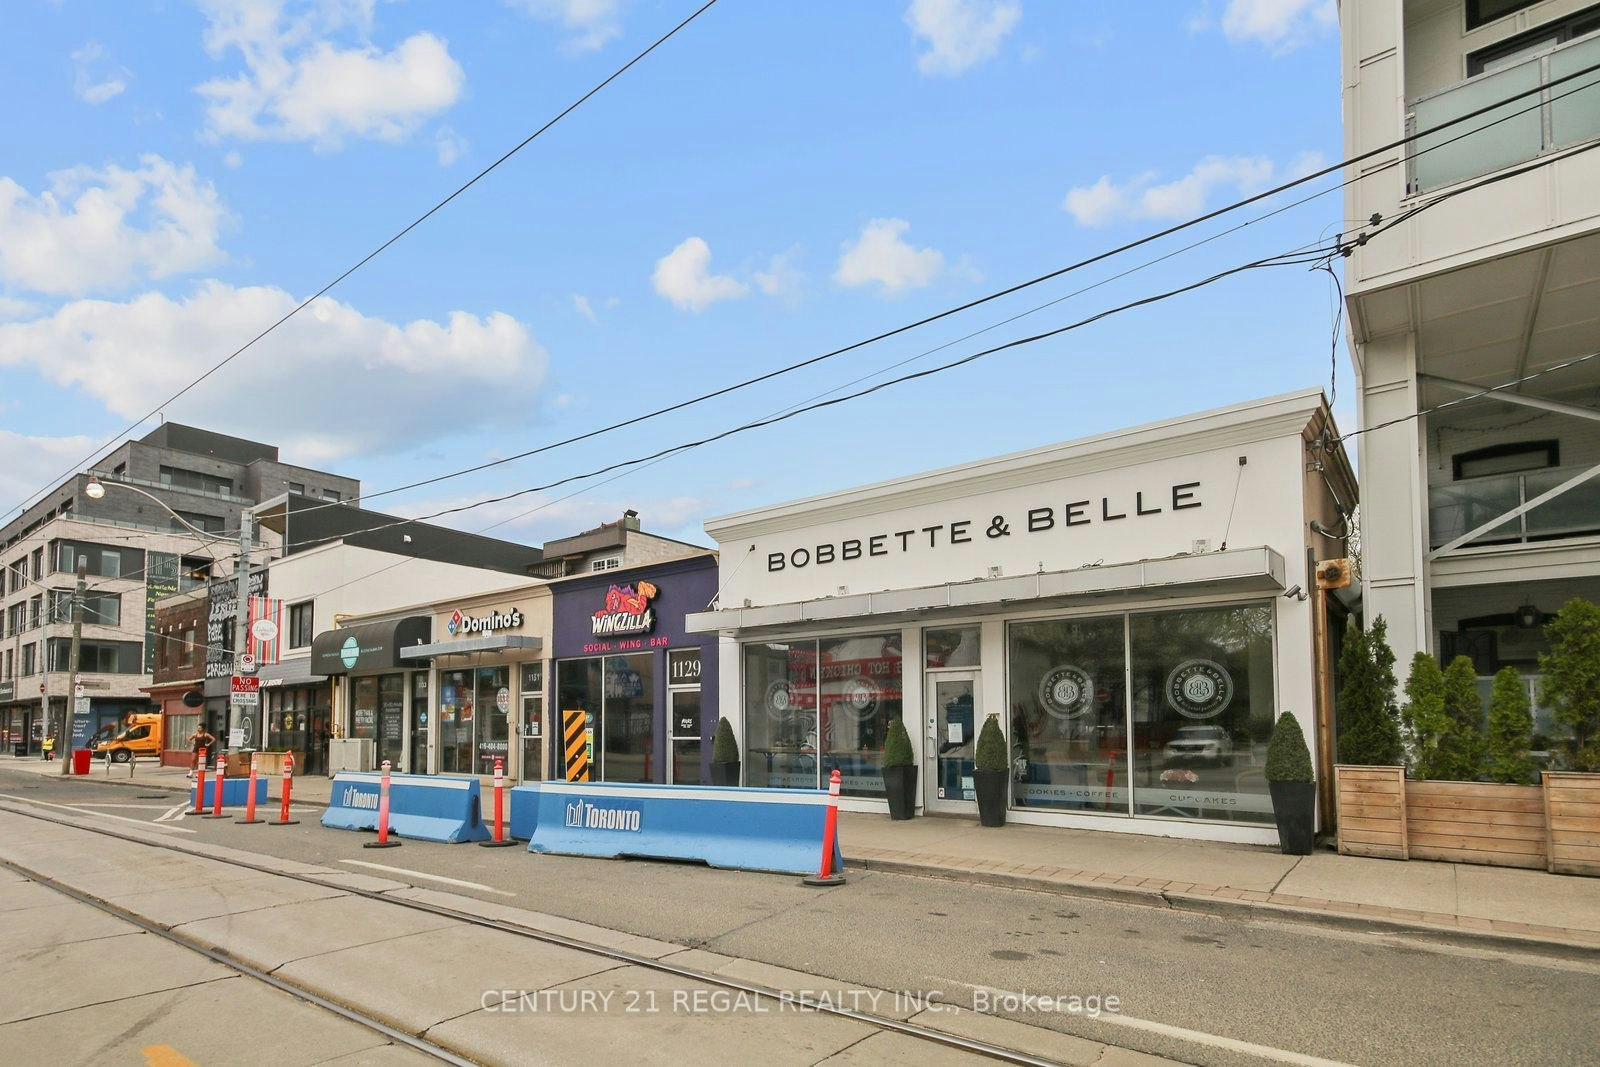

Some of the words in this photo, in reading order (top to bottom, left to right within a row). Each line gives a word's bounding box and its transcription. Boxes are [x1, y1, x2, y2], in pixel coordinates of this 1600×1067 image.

[768, 520, 972, 572] BOBBETTE
[986, 514, 1011, 538] &
[1028, 481, 1202, 533] BELLE
[462, 607, 520, 633] Domino's
[584, 642, 611, 653] SOCIAL
[619, 639, 641, 650] WING
[650, 636, 669, 647] BAR
[672, 660, 701, 678] 1129
[232, 684, 258, 692] PASSING
[352, 788, 379, 810] TORONTO
[1076, 790, 1119, 799] COFFEE
[584, 803, 641, 832] TORONTO
